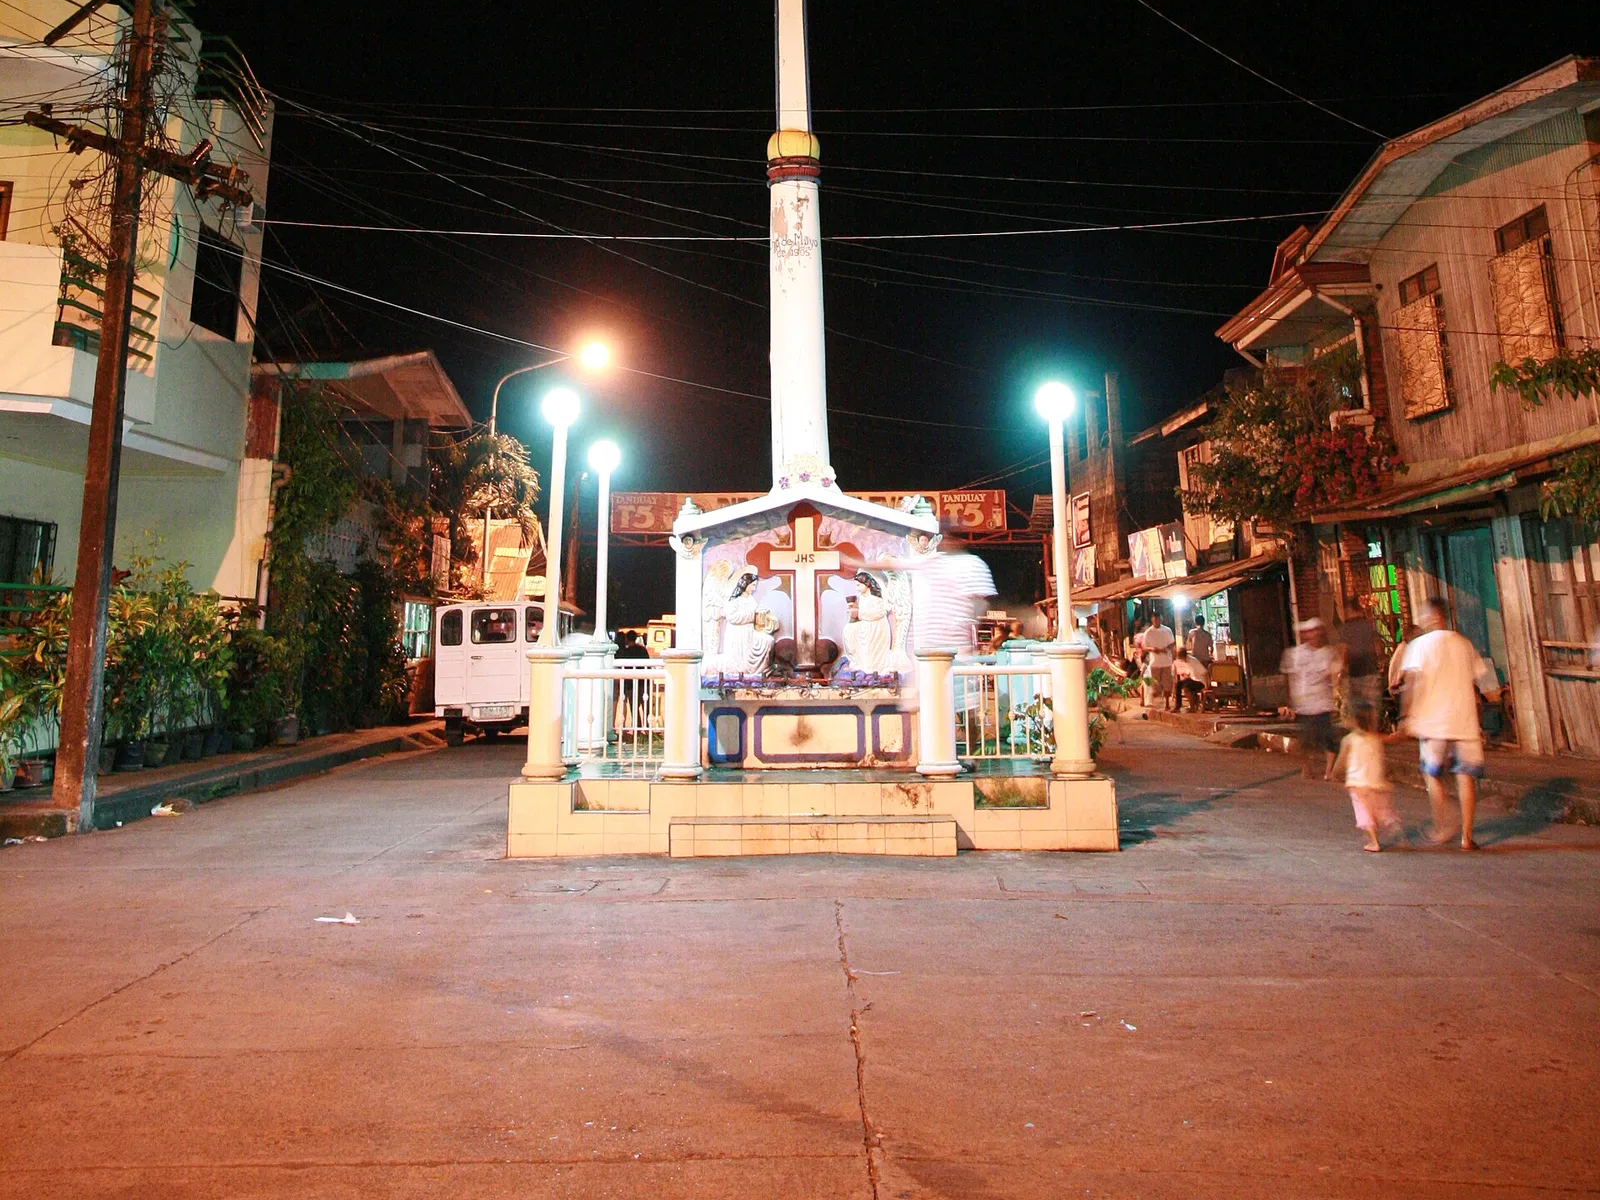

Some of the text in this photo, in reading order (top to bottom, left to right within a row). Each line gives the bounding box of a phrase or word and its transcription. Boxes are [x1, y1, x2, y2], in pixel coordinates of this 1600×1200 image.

[794, 231, 818, 250] Mayo
[614, 495, 657, 505] TANDUAY
[942, 493, 987, 503] TANDUAY
[615, 505, 655, 529] T5
[943, 503, 985, 527] T5
[794, 554, 815, 564] JHS
